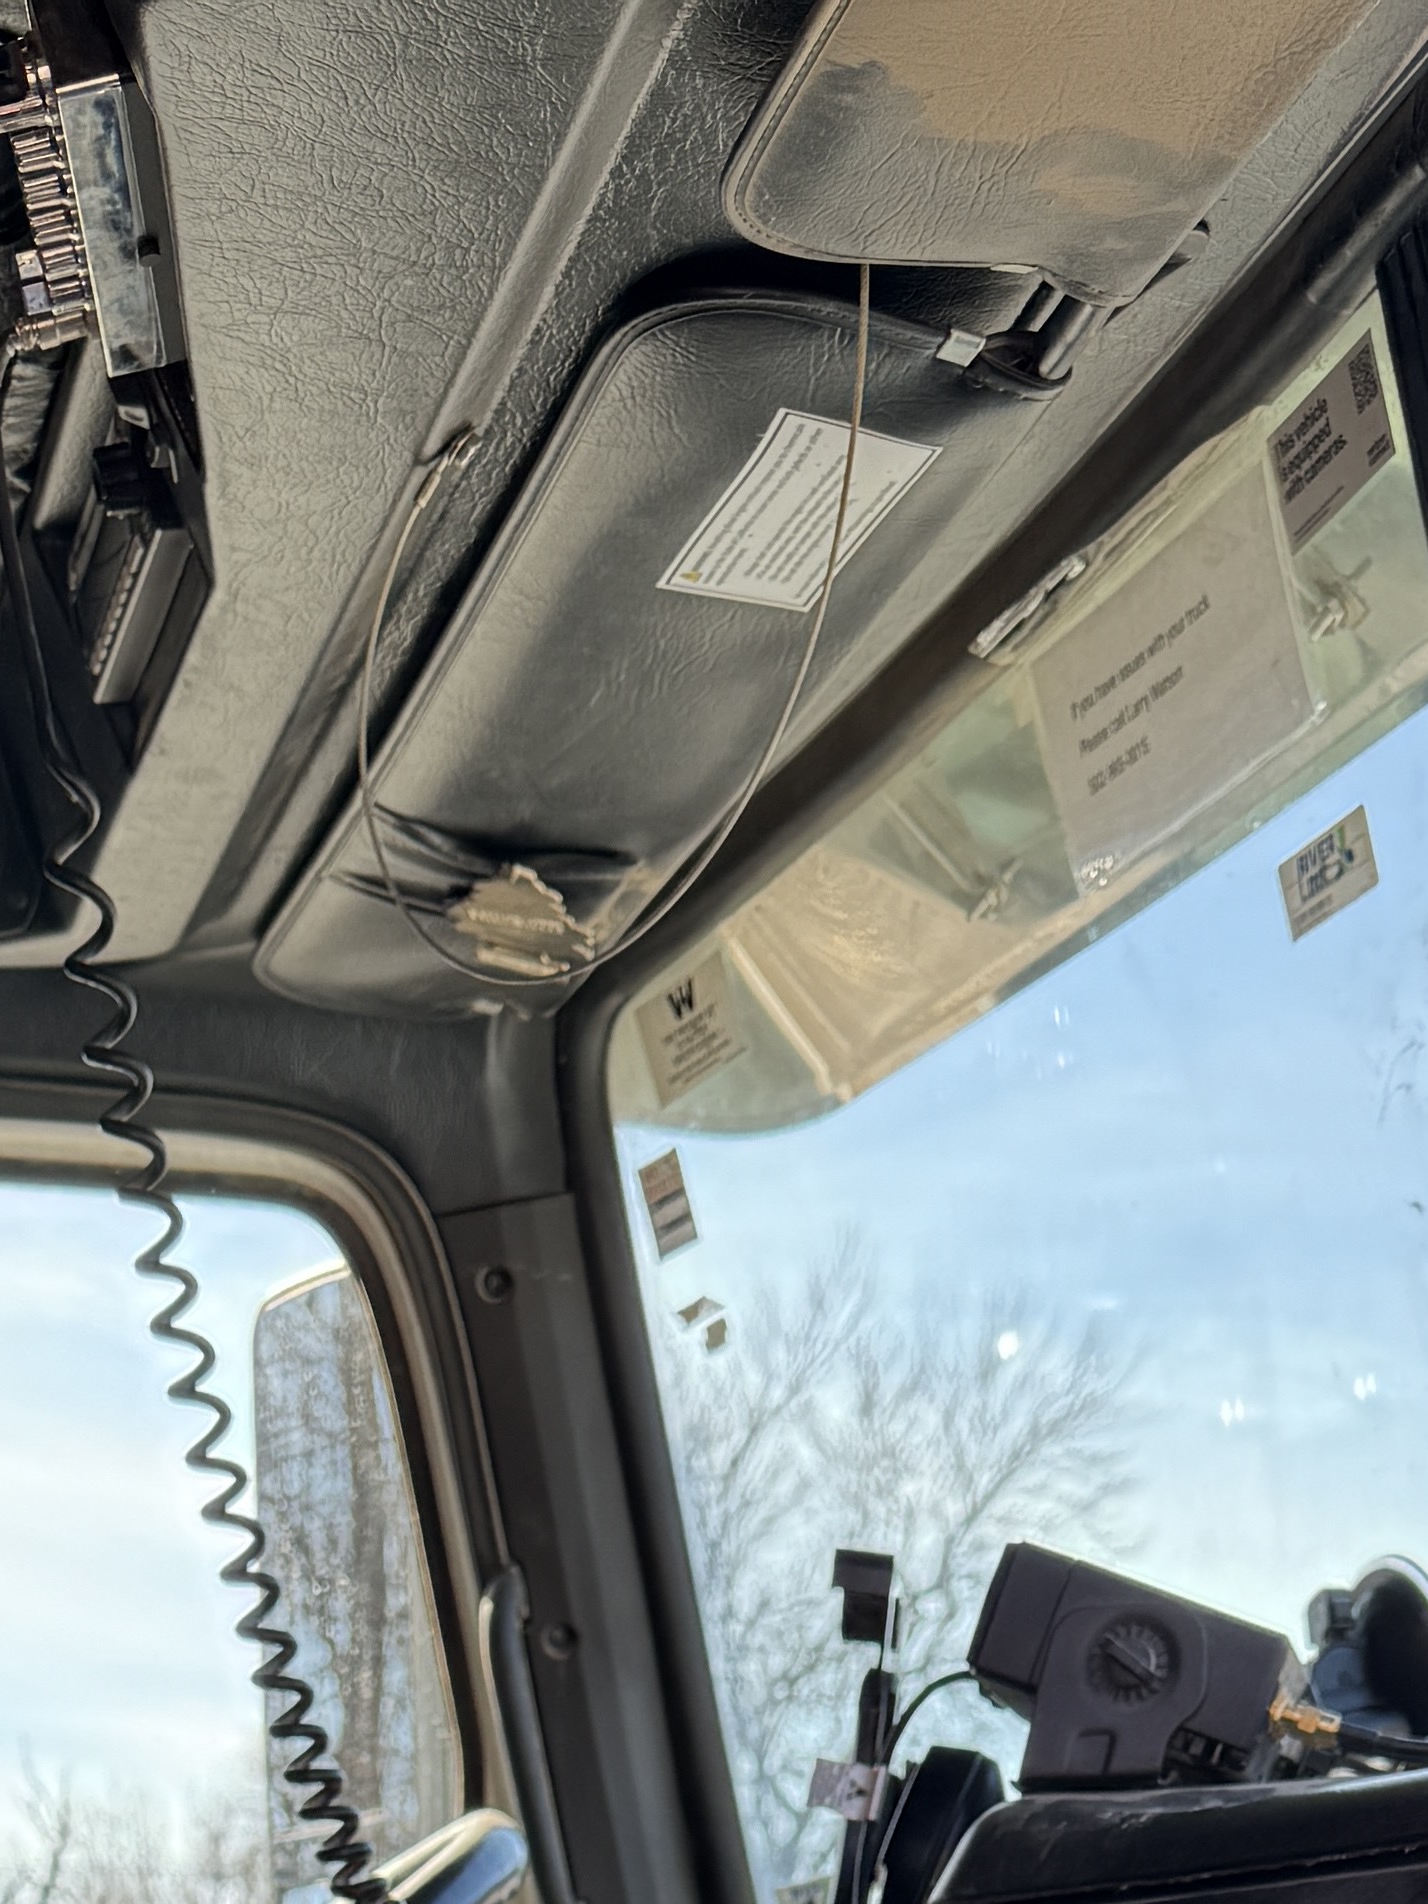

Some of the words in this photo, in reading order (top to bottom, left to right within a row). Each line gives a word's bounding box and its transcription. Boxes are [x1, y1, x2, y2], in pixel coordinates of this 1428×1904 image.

[1274, 433, 1295, 460] This
[1294, 398, 1328, 441] vehicle
[1287, 417, 1332, 475] equipped
[1284, 474, 1305, 502] with
[1094, 675, 1117, 700] have
[1116, 651, 1146, 682] issues
[1146, 633, 1165, 658] with
[1165, 617, 1185, 646] your
[1184, 594, 1209, 625] truck
